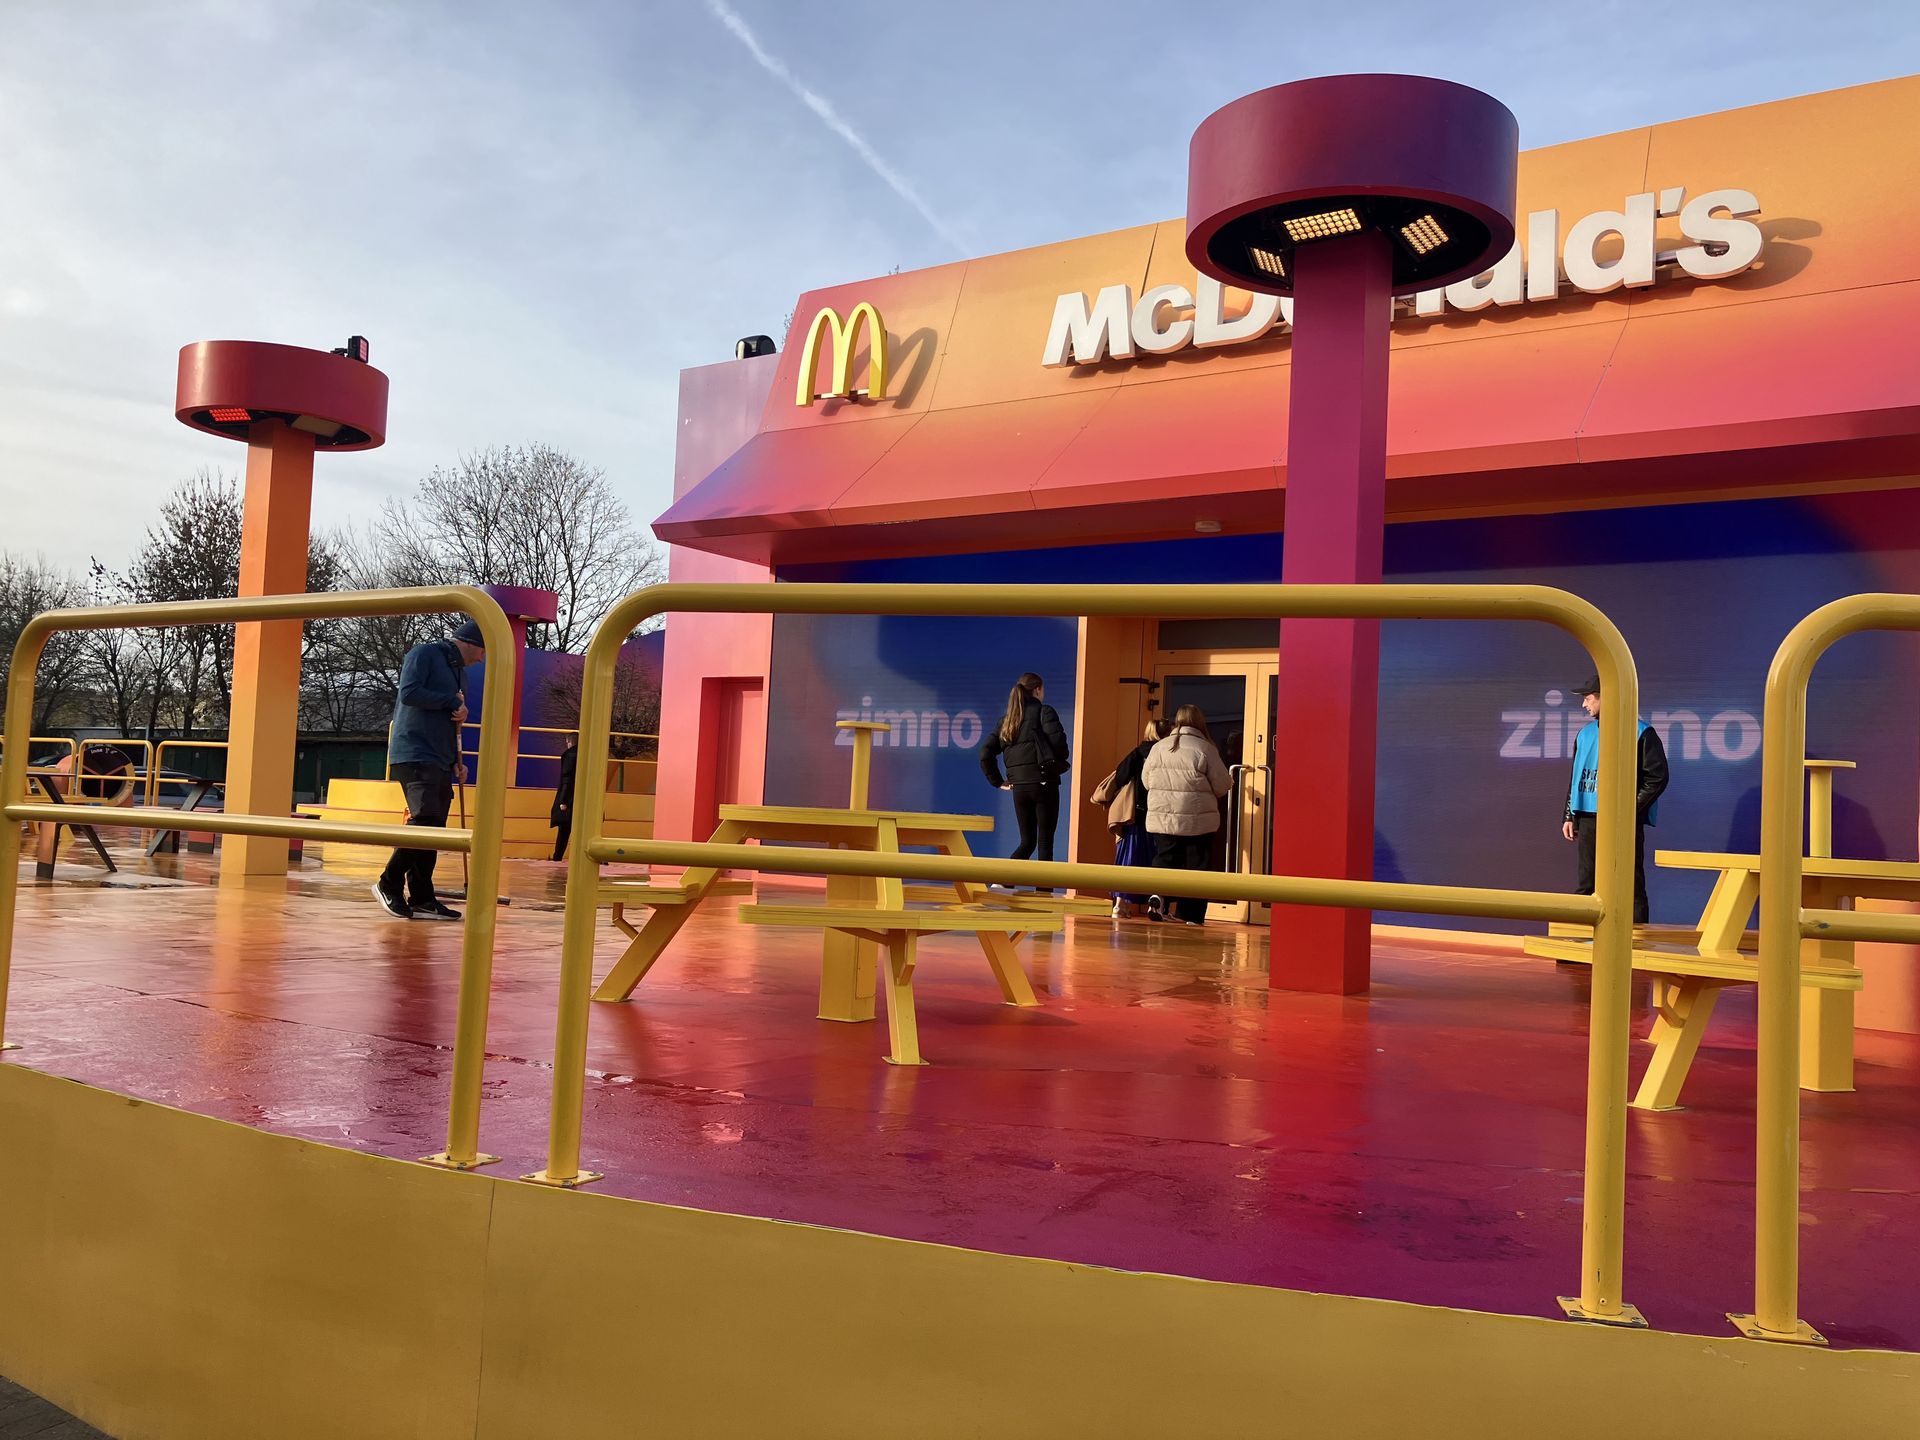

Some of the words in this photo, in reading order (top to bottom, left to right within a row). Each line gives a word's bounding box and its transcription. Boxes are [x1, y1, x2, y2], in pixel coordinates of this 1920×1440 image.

[1041, 186, 1763, 369] McDald's
[834, 696, 982, 749] zimno
[1500, 690, 1761, 761] zino
